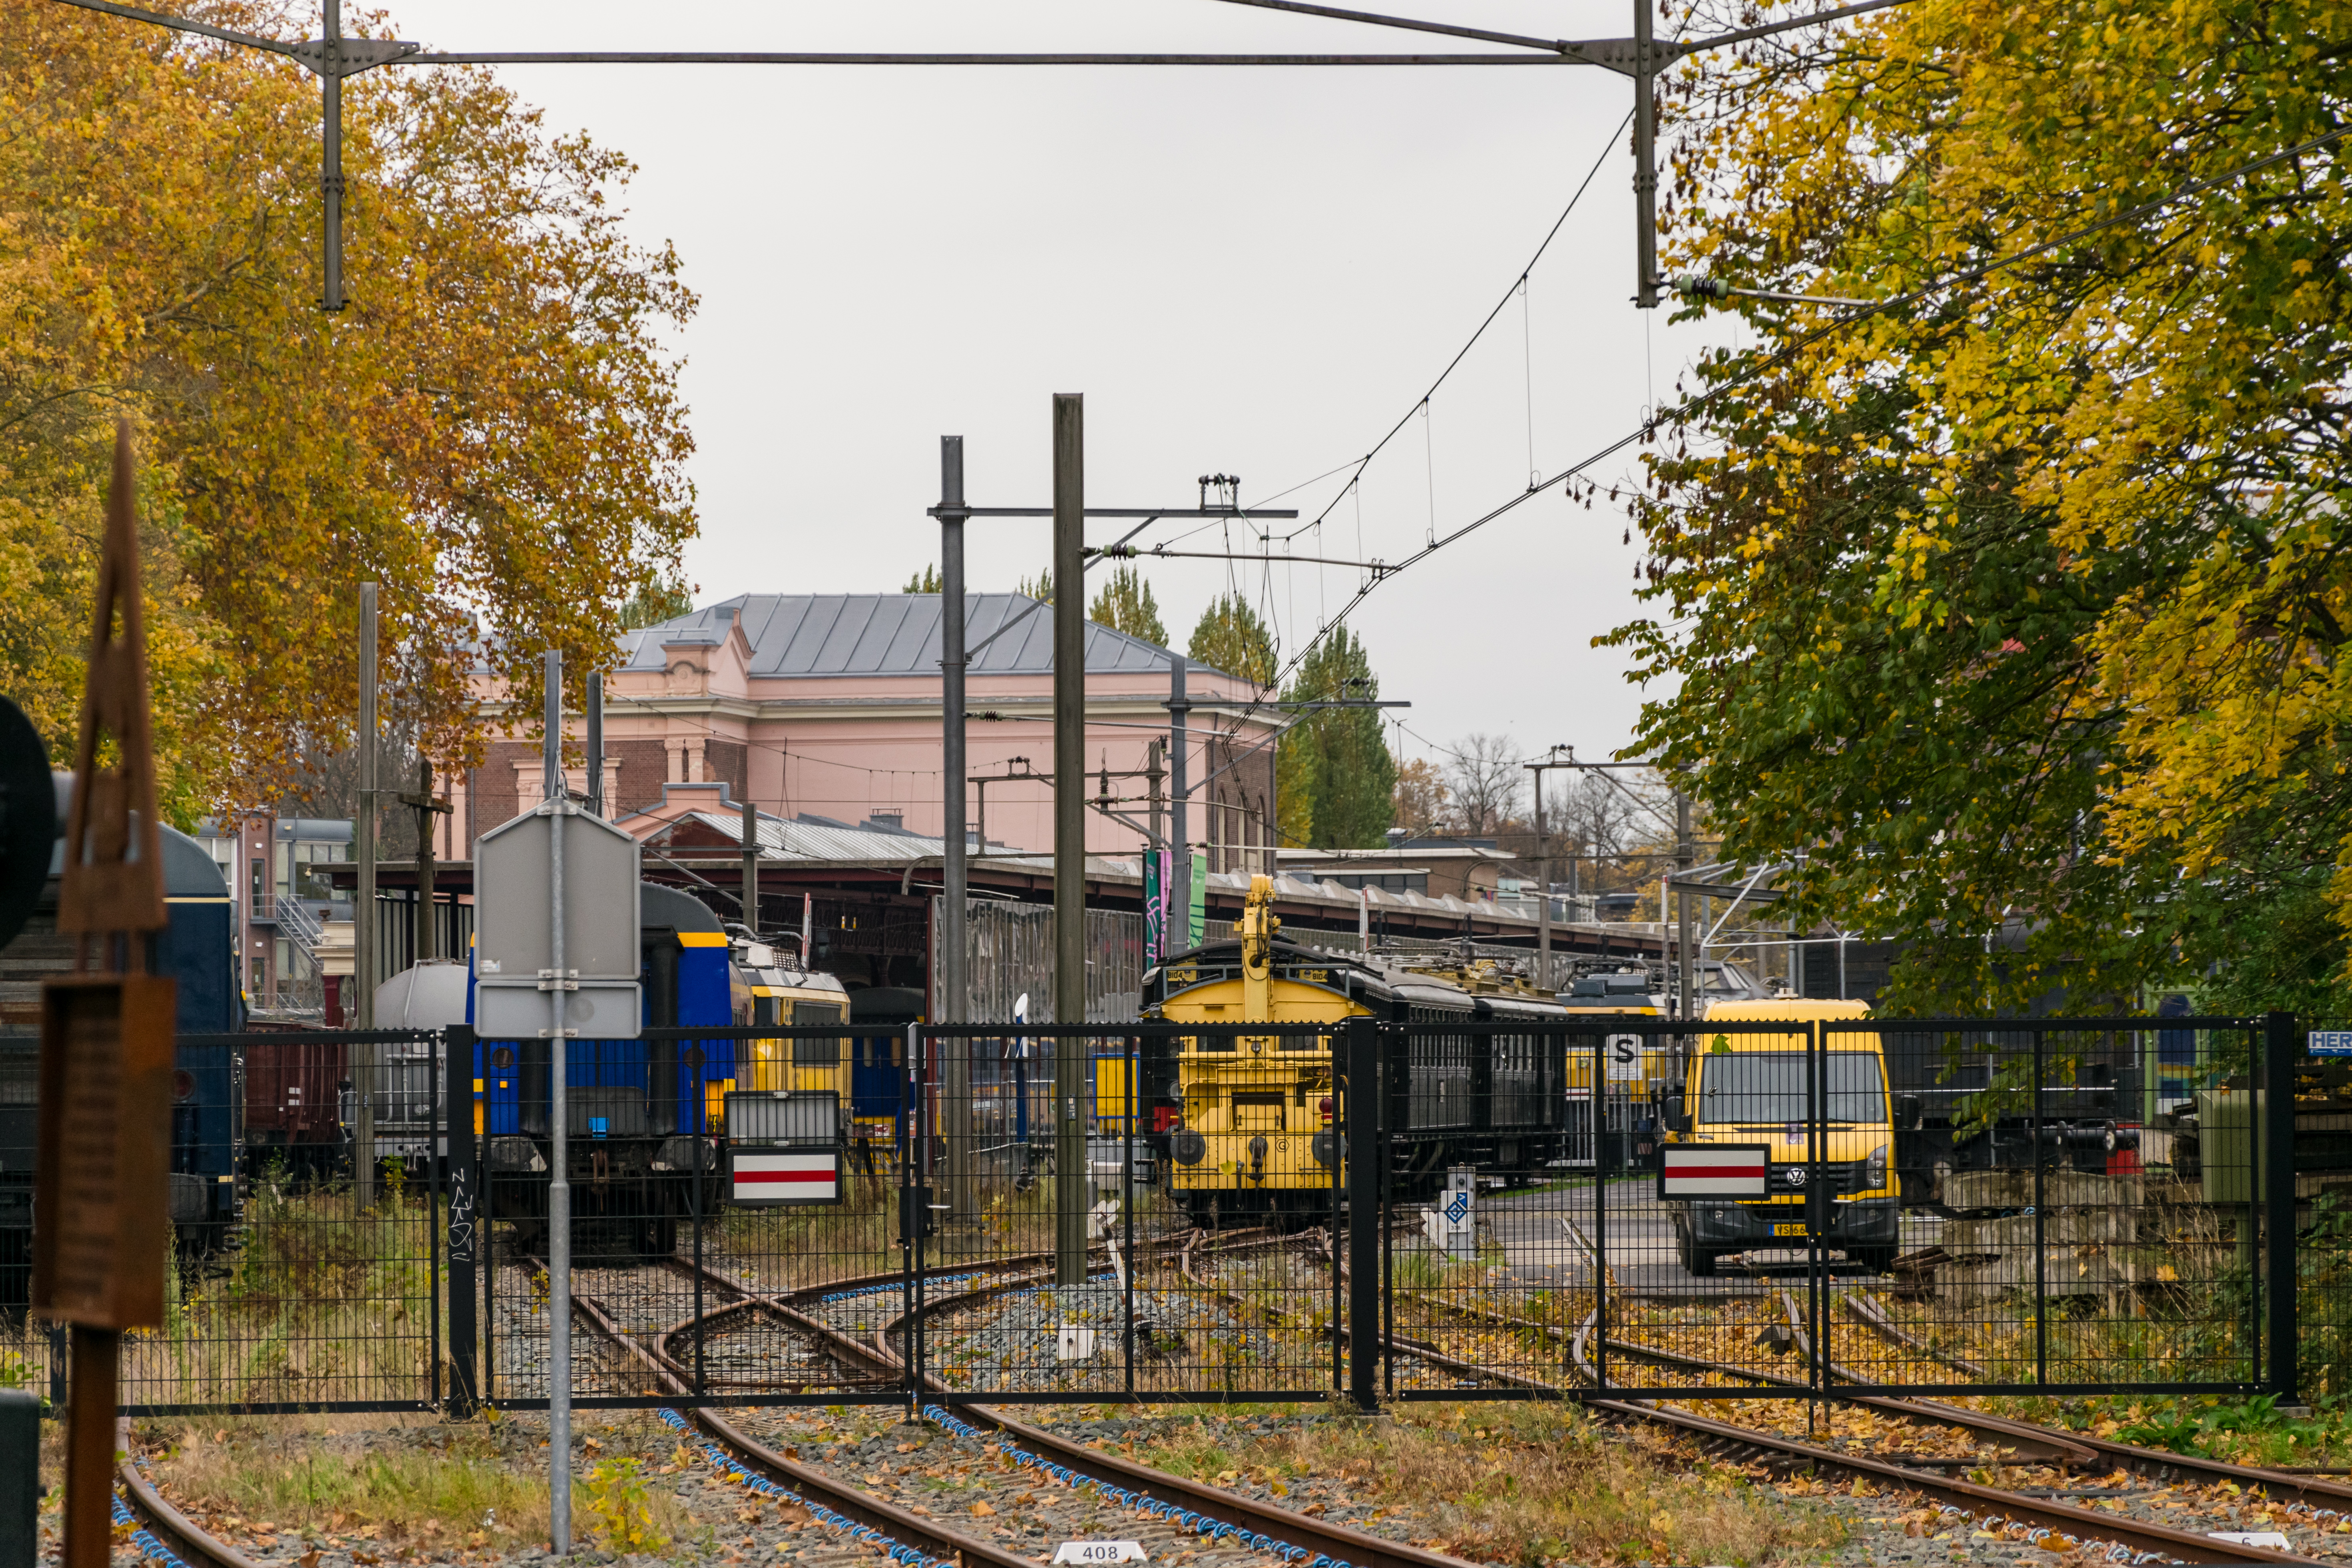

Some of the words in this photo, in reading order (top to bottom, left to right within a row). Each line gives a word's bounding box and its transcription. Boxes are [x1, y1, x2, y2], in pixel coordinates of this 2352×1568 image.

[1615, 1039, 1634, 1063] S
[1279, 1141, 1286, 1150] G
[1083, 1546, 1118, 1559] 408
